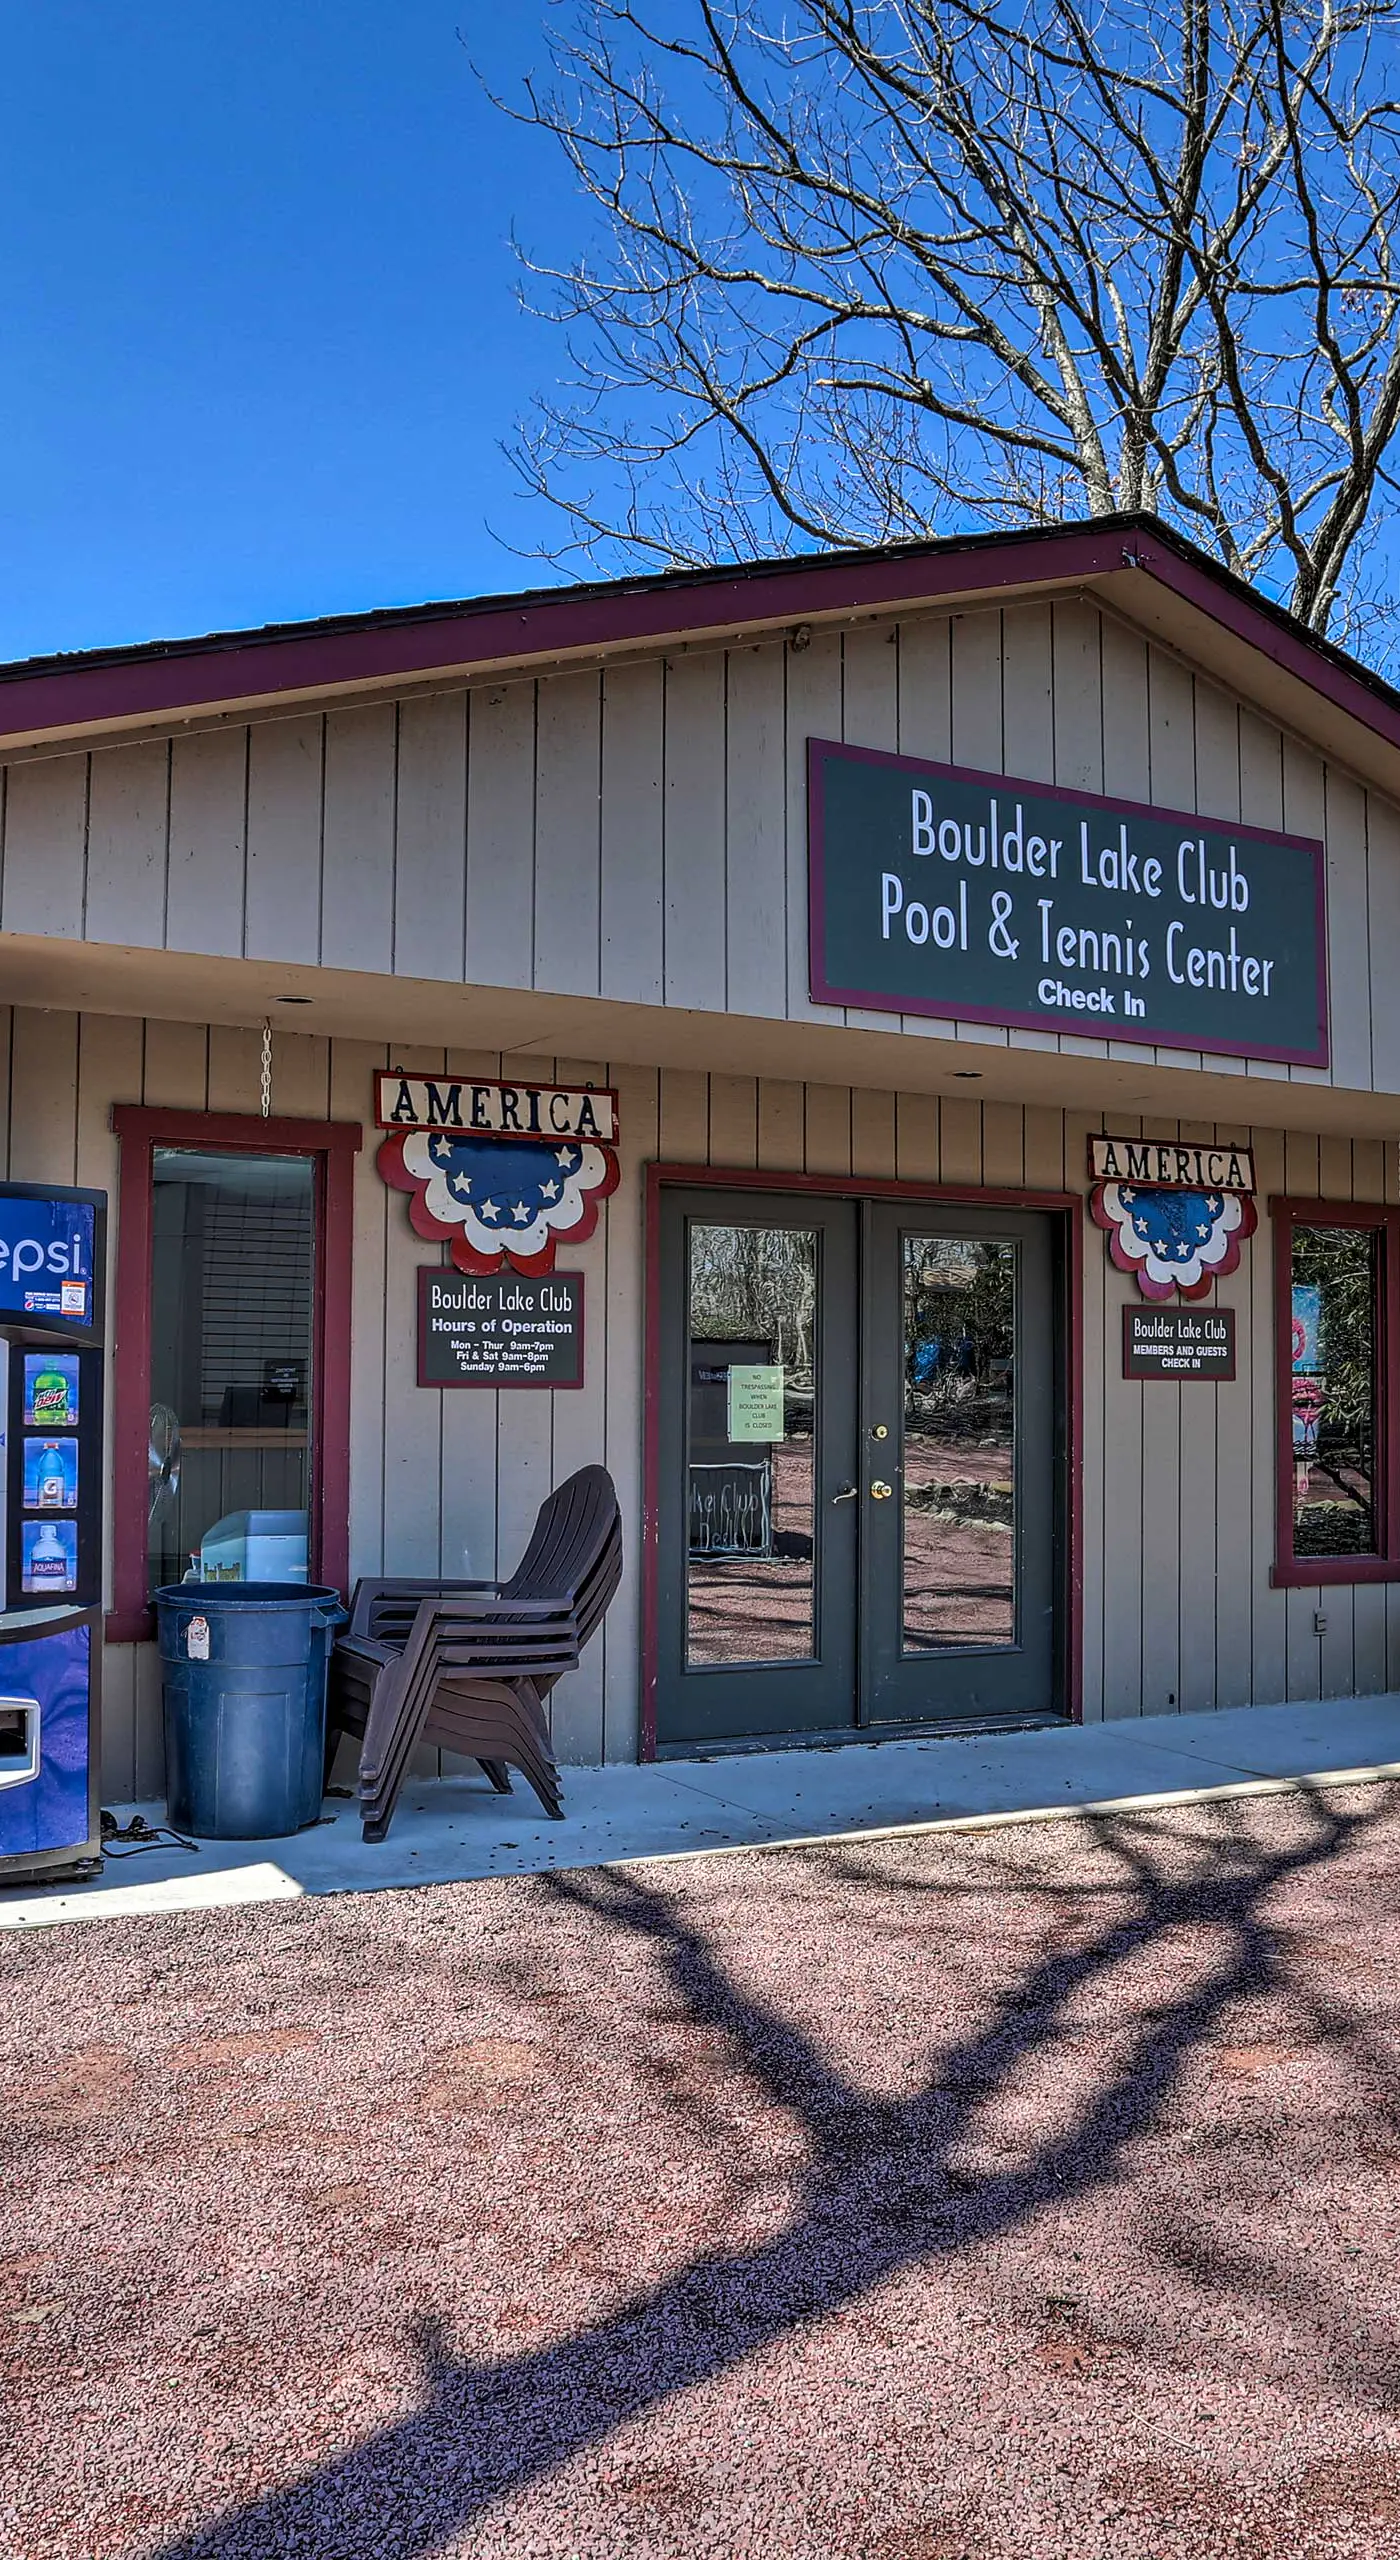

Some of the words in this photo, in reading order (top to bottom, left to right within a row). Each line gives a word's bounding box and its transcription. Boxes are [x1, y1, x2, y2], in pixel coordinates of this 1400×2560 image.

[912, 789, 1063, 878] Boulder
[1080, 821, 1163, 898] Lake
[1177, 839, 1250, 913] Club
[881, 872, 968, 951] Pool
[989, 890, 1020, 961] &
[1037, 899, 1150, 979] Tennis
[1166, 921, 1274, 996] Center
[1038, 979, 1115, 1014] Check
[1123, 990, 1146, 1018] In
[390, 1080, 603, 1136] AMERICA
[1102, 1142, 1246, 1188] AMERICA
[432, 1284, 492, 1310] Boulder
[499, 1286, 534, 1311] Lake
[540, 1286, 572, 1312] Club
[432, 1318, 476, 1332] Hours
[481, 1319, 497, 1332] of
[501, 1319, 572, 1336] Operation
[1134, 1317, 1174, 1338] Boulder
[1178, 1318, 1201, 1339] Lake
[1205, 1319, 1226, 1339] Club
[451, 1341, 471, 1350] Mon
[482, 1341, 504, 1350] Thur
[510, 1341, 554, 1351] 9am-7pm
[1133, 1345, 1174, 1356] MEMBERS
[1176, 1345, 1194, 1356] AND
[1196, 1346, 1227, 1357] GUESTS
[456, 1351, 469, 1360] Fri
[472, 1352, 479, 1360] &
[483, 1351, 499, 1361] Sat
[502, 1352, 549, 1362] 9am-8pm
[1161, 1358, 1190, 1368] CHECK
[1192, 1359, 1201, 1368] IN
[460, 1362, 495, 1373] Sunday
[498, 1362, 545, 1373] 9am-6pm
[34, 1563, 64, 1573] AQUAFINA
